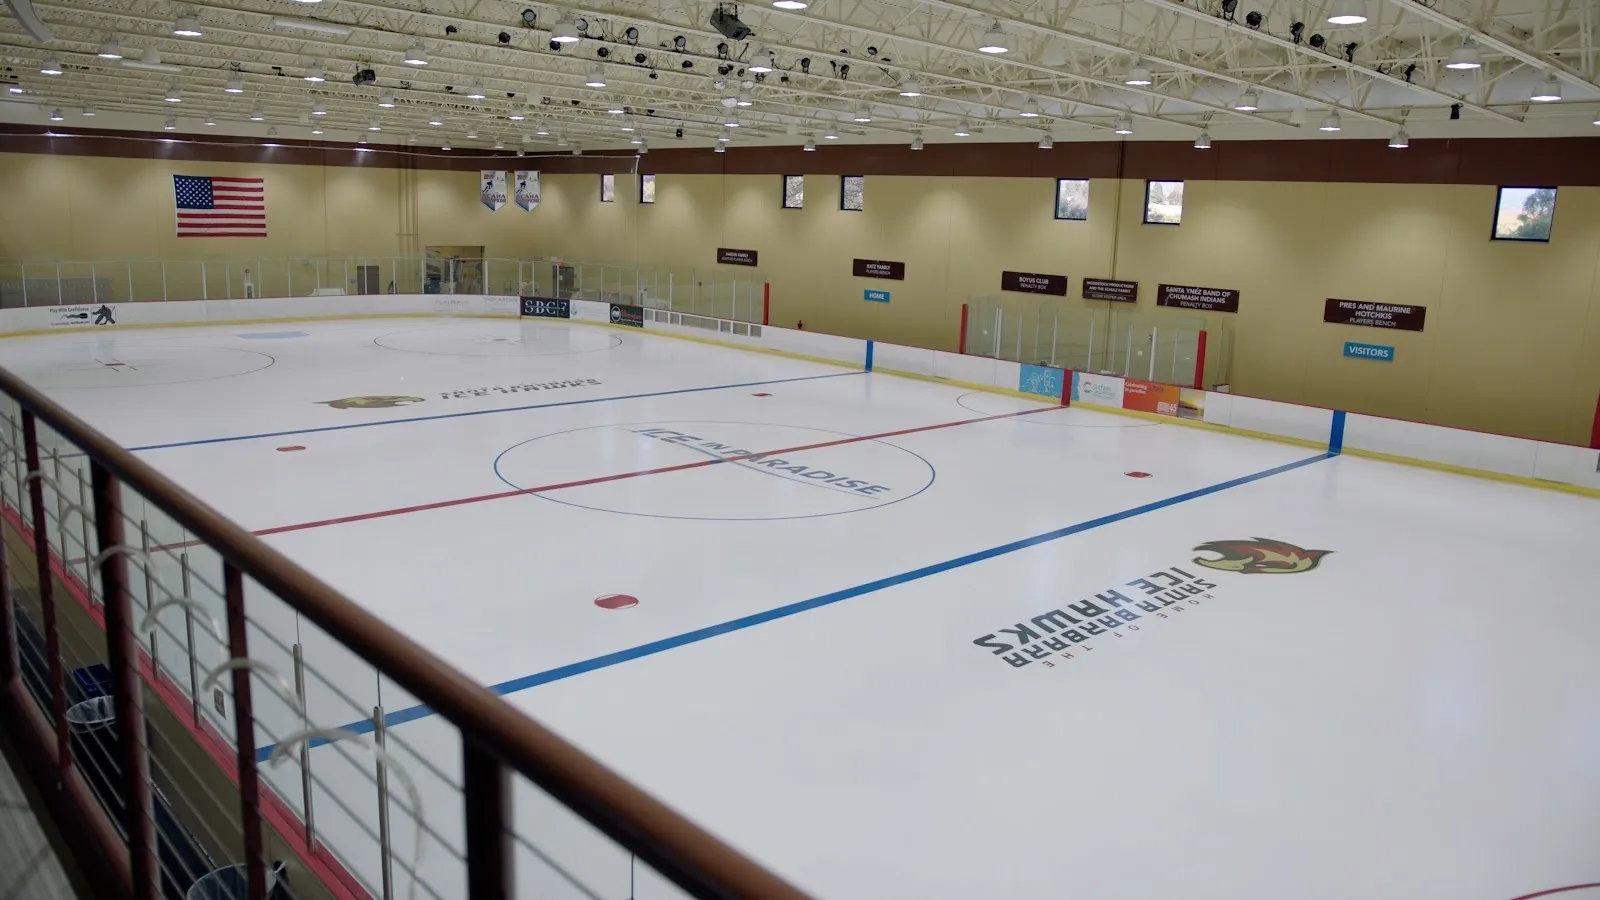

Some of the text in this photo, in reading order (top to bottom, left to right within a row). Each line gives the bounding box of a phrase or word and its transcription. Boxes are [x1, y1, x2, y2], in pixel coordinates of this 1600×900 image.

[869, 291, 885, 300] HOME
[1165, 286, 1185, 294] SANTA
[1202, 289, 1221, 297] BAND
[1169, 293, 1226, 304] CHUMASH INDIANS
[1339, 301, 1411, 314] PRES AND MAURINE
[1349, 317, 1374, 326] PLAYERS
[1355, 310, 1393, 320] HOTCHKIS
[1349, 345, 1389, 358] VISITORS
[632, 428, 892, 495] ICE IN PARADISE
[973, 566, 1197, 656] ICE HAWKS
[1002, 578, 1217, 668] SANTA BARBARA
[1042, 593, 1216, 668] HOME OF THE
